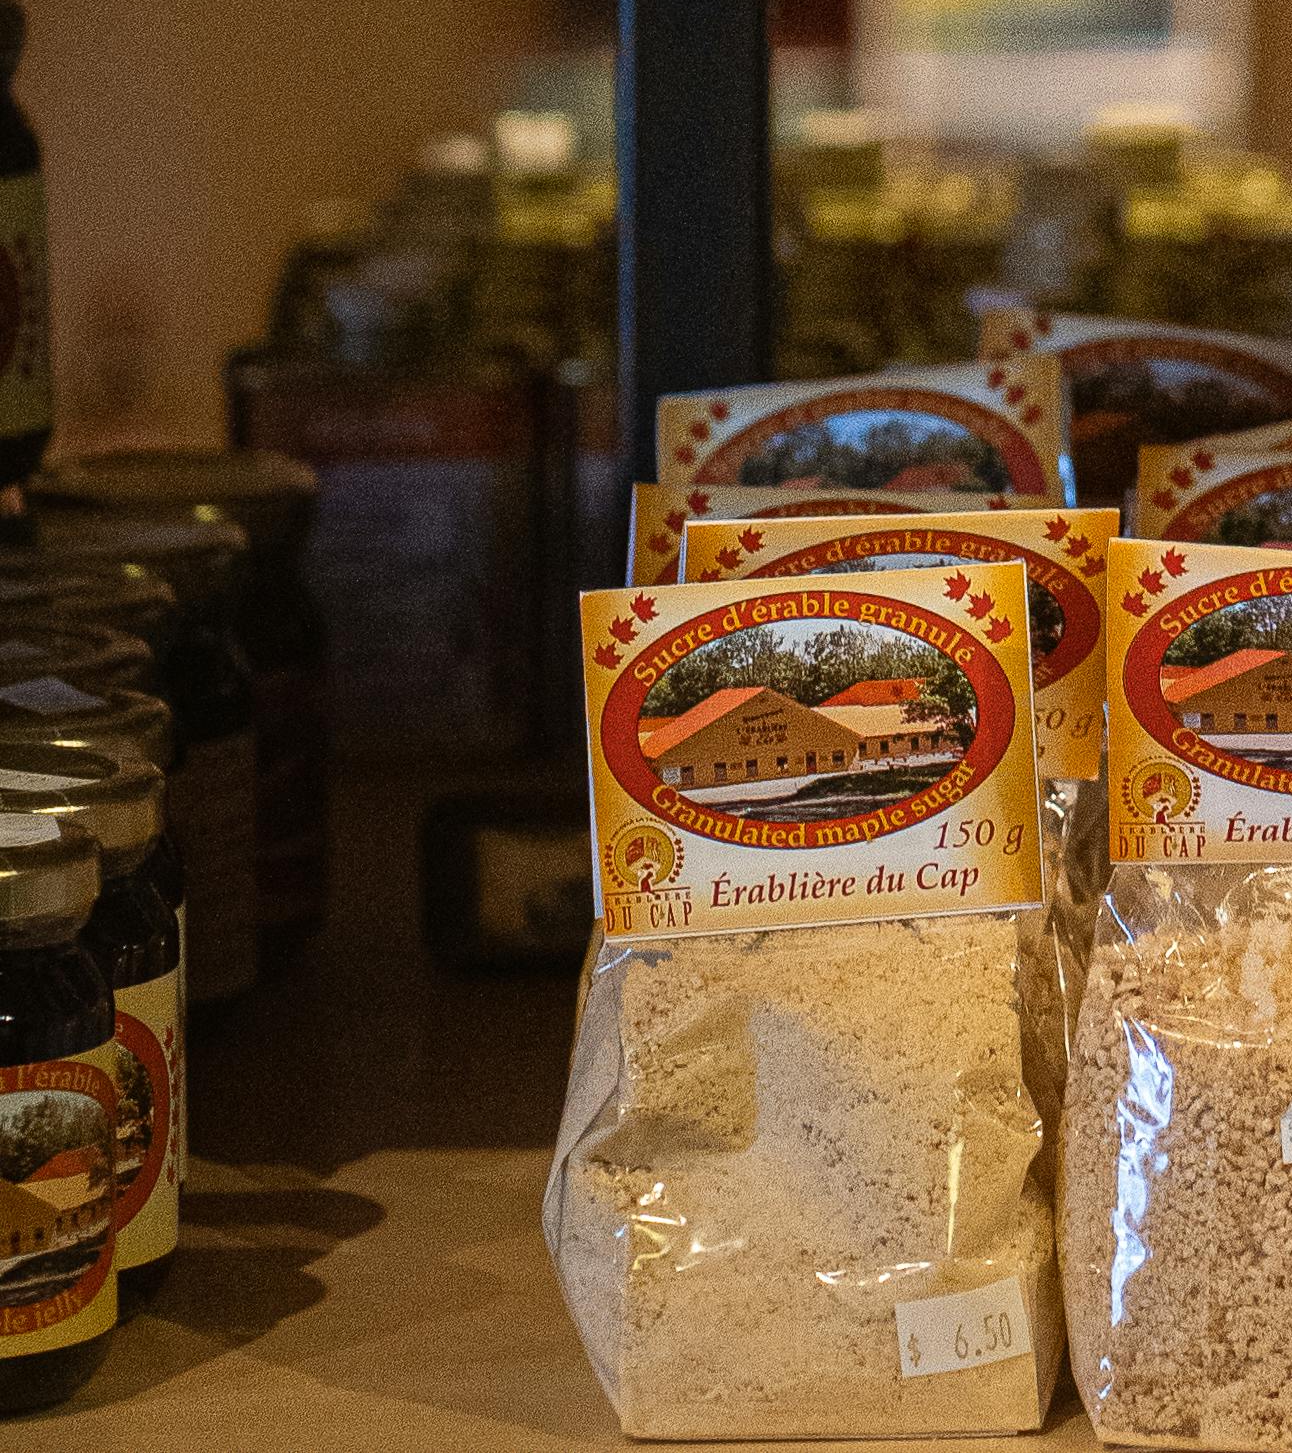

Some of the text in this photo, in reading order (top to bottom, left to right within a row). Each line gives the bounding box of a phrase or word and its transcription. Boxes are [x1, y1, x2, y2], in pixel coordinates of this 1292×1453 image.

[1158, 585, 1240, 639] Sucre
[634, 593, 975, 688] Sucre d'érable granulé
[651, 760, 977, 847] Granulated maple sugar
[934, 819, 1025, 855] 150 g
[1118, 834, 1207, 859] DU CAP
[709, 861, 980, 909] Érablière du Cap
[606, 901, 692, 933] DU CAP
[955, 1312, 1011, 1359] 6.50
